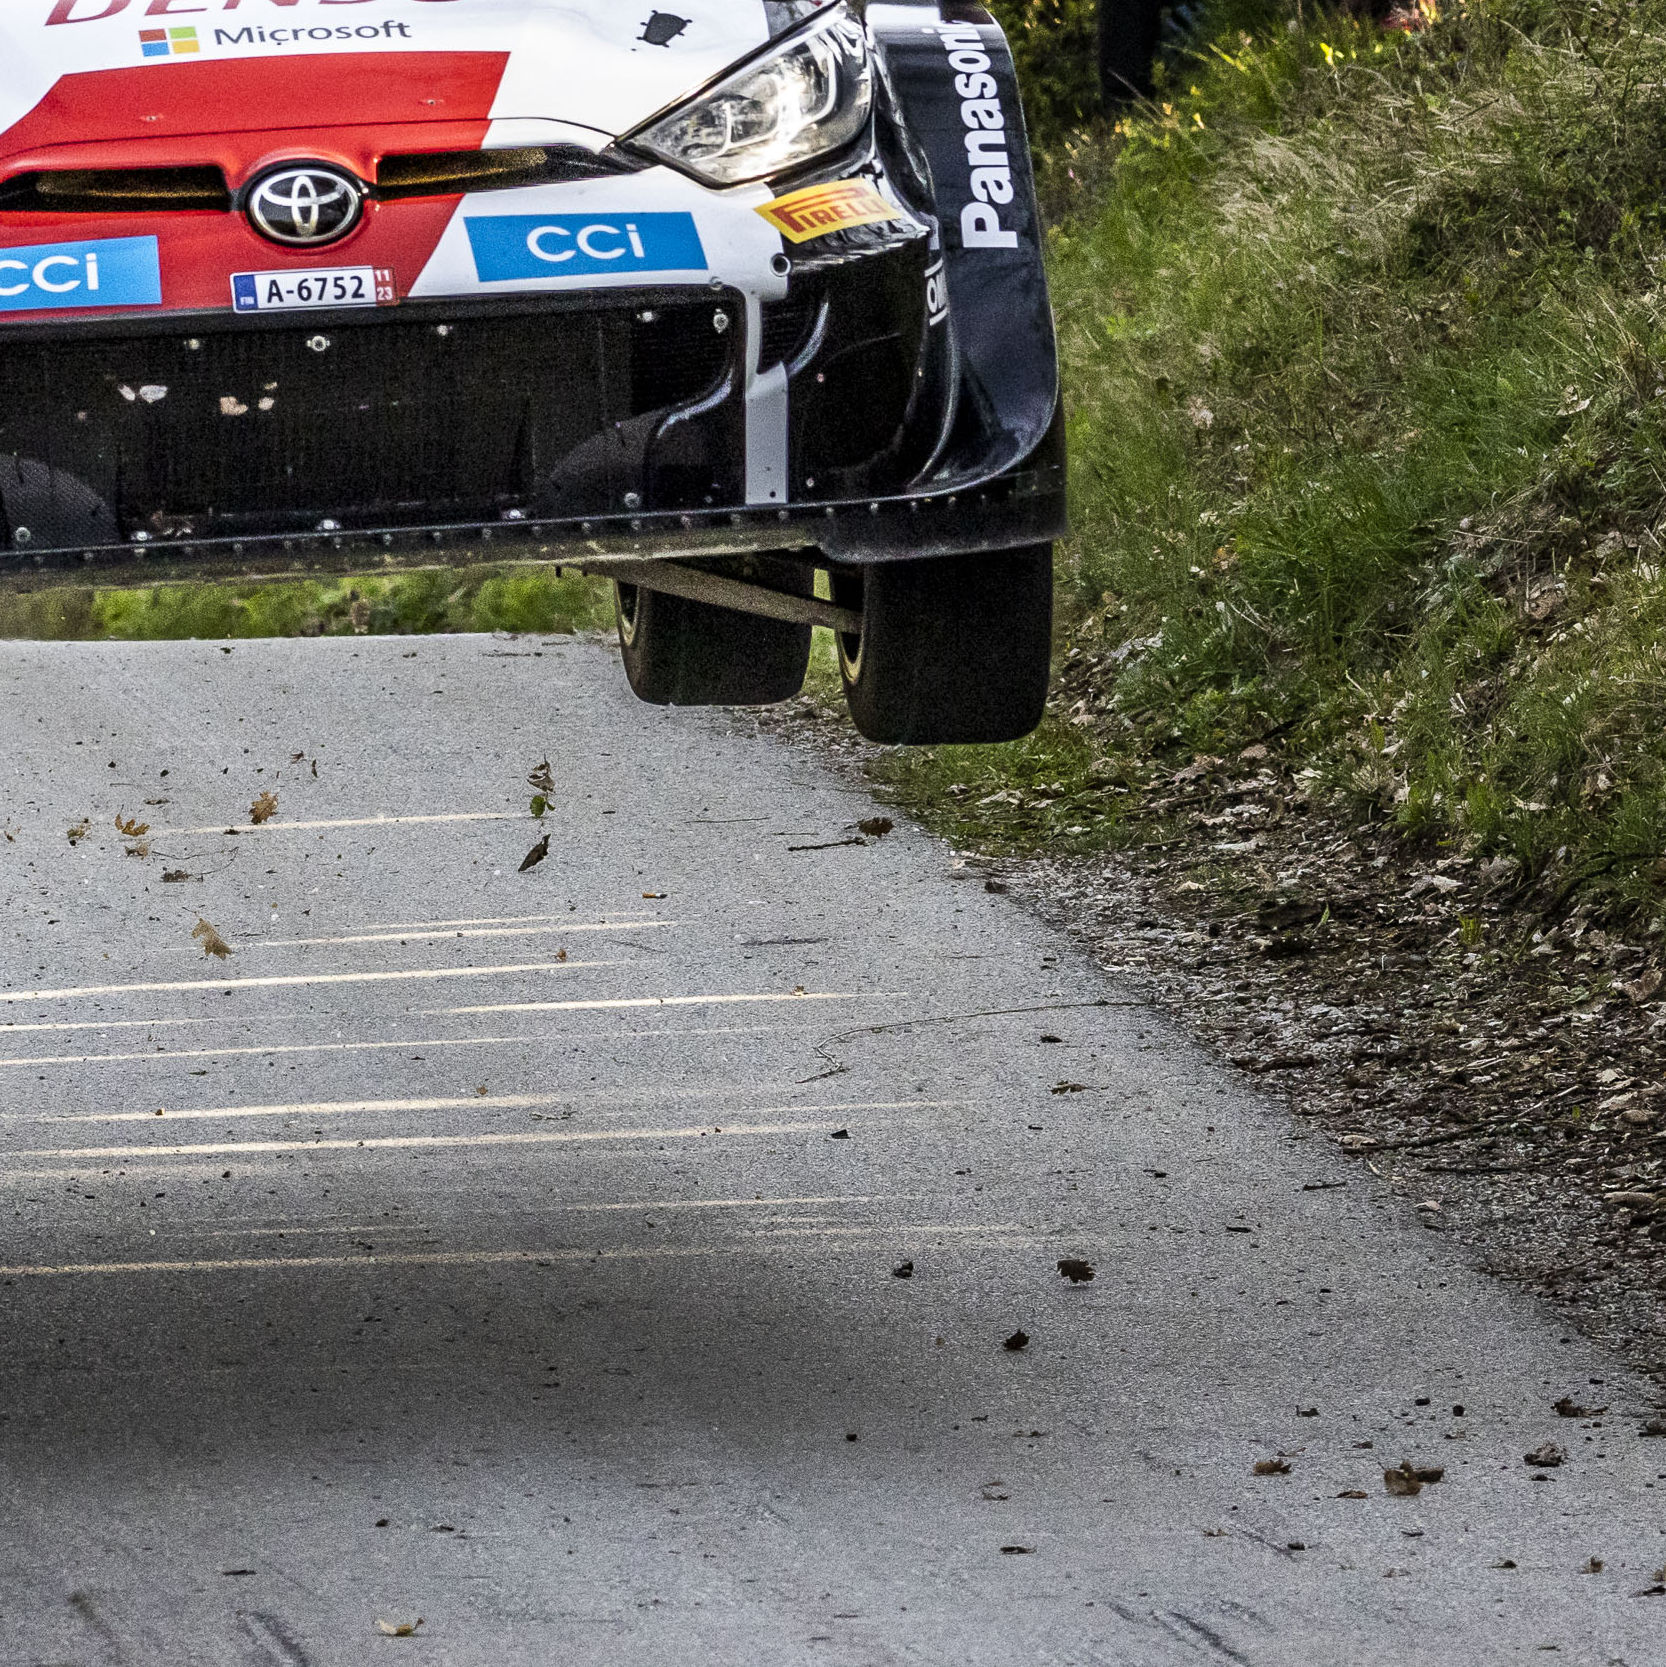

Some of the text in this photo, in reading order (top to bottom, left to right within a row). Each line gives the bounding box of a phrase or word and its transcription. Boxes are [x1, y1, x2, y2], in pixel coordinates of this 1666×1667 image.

[213, 19, 413, 46] Microsoft
[375, 270, 390, 282] 11
[267, 275, 366, 304] A-6752
[376, 286, 393, 301] 23
